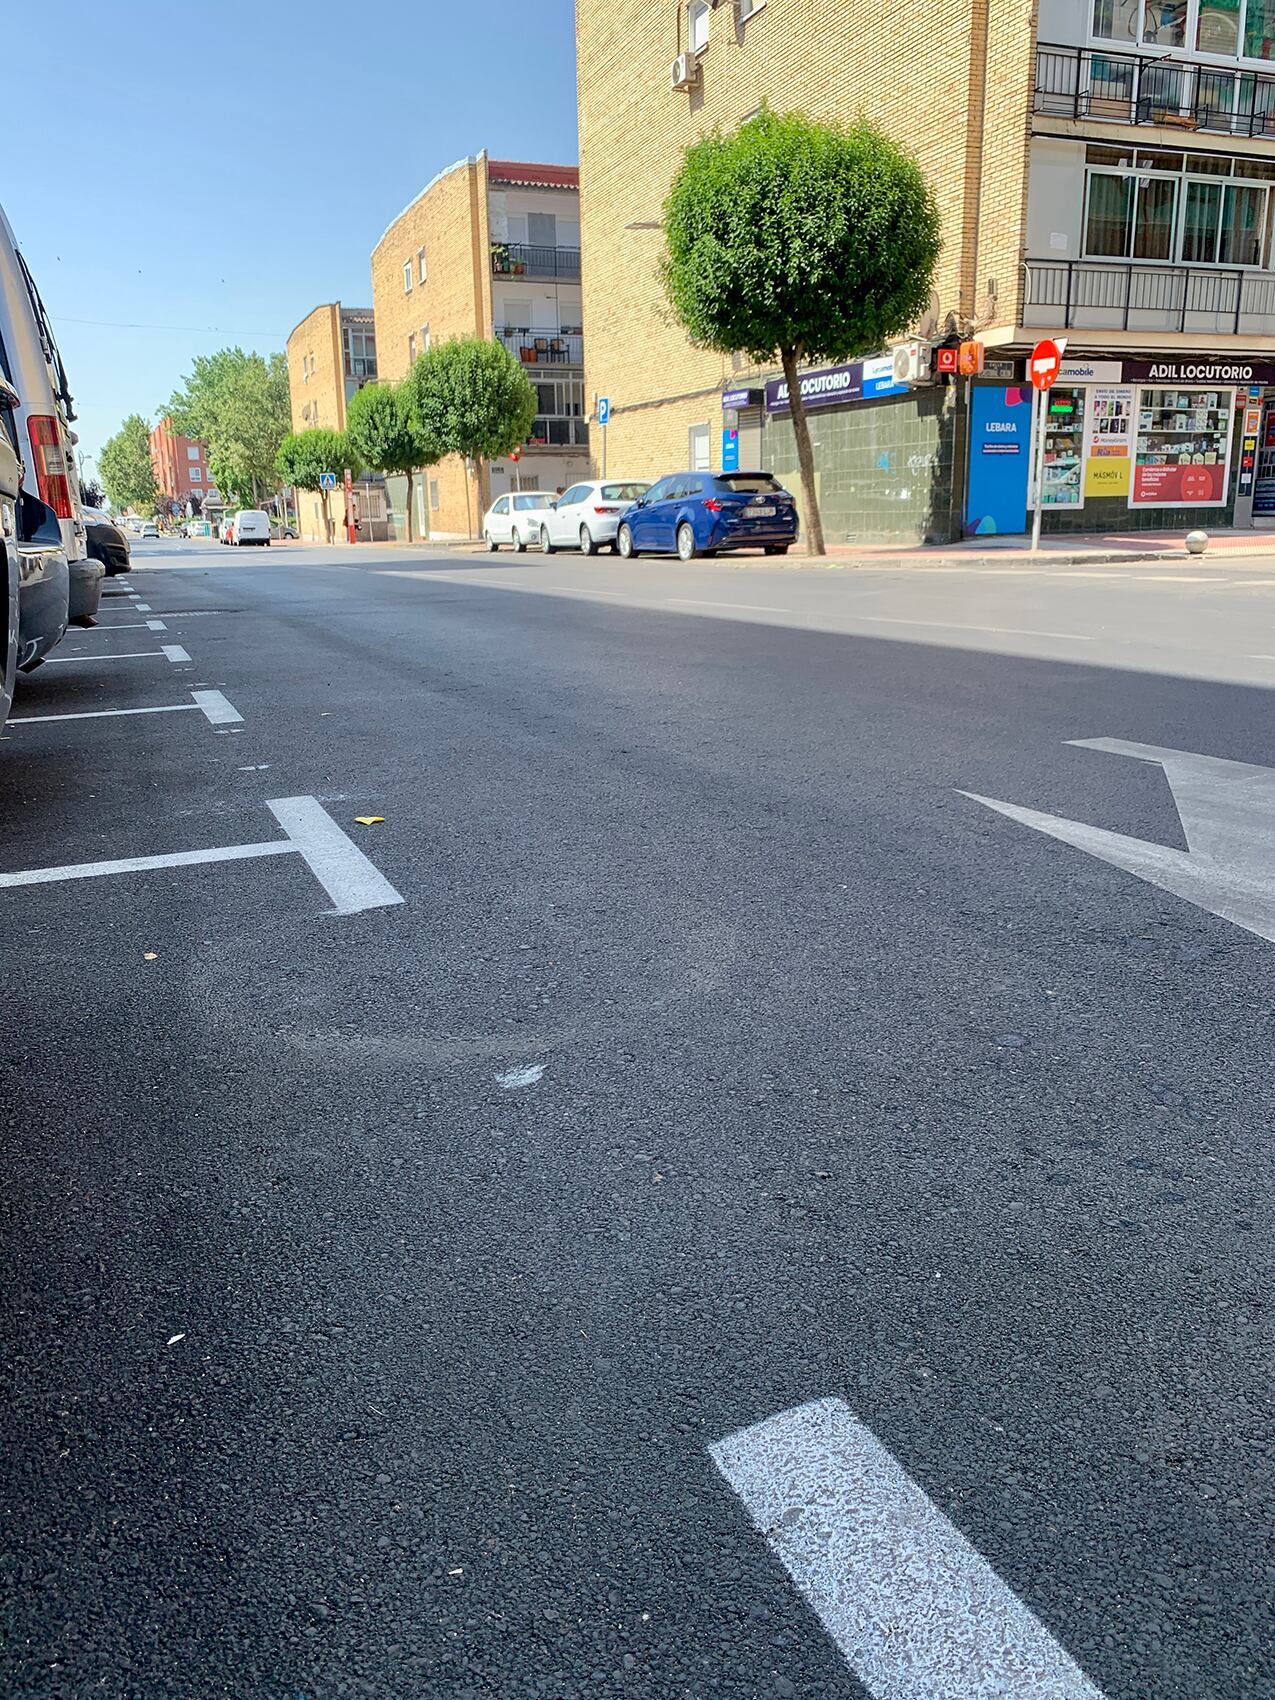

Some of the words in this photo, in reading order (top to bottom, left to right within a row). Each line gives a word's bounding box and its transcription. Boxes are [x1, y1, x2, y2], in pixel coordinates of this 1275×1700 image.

[1059, 367, 1095, 377] camobile
[1149, 364, 1178, 379] ADIL
[1180, 365, 1253, 380] LOCUTORIO
[600, 401, 607, 421] P
[986, 422, 1017, 432] LEBARA
